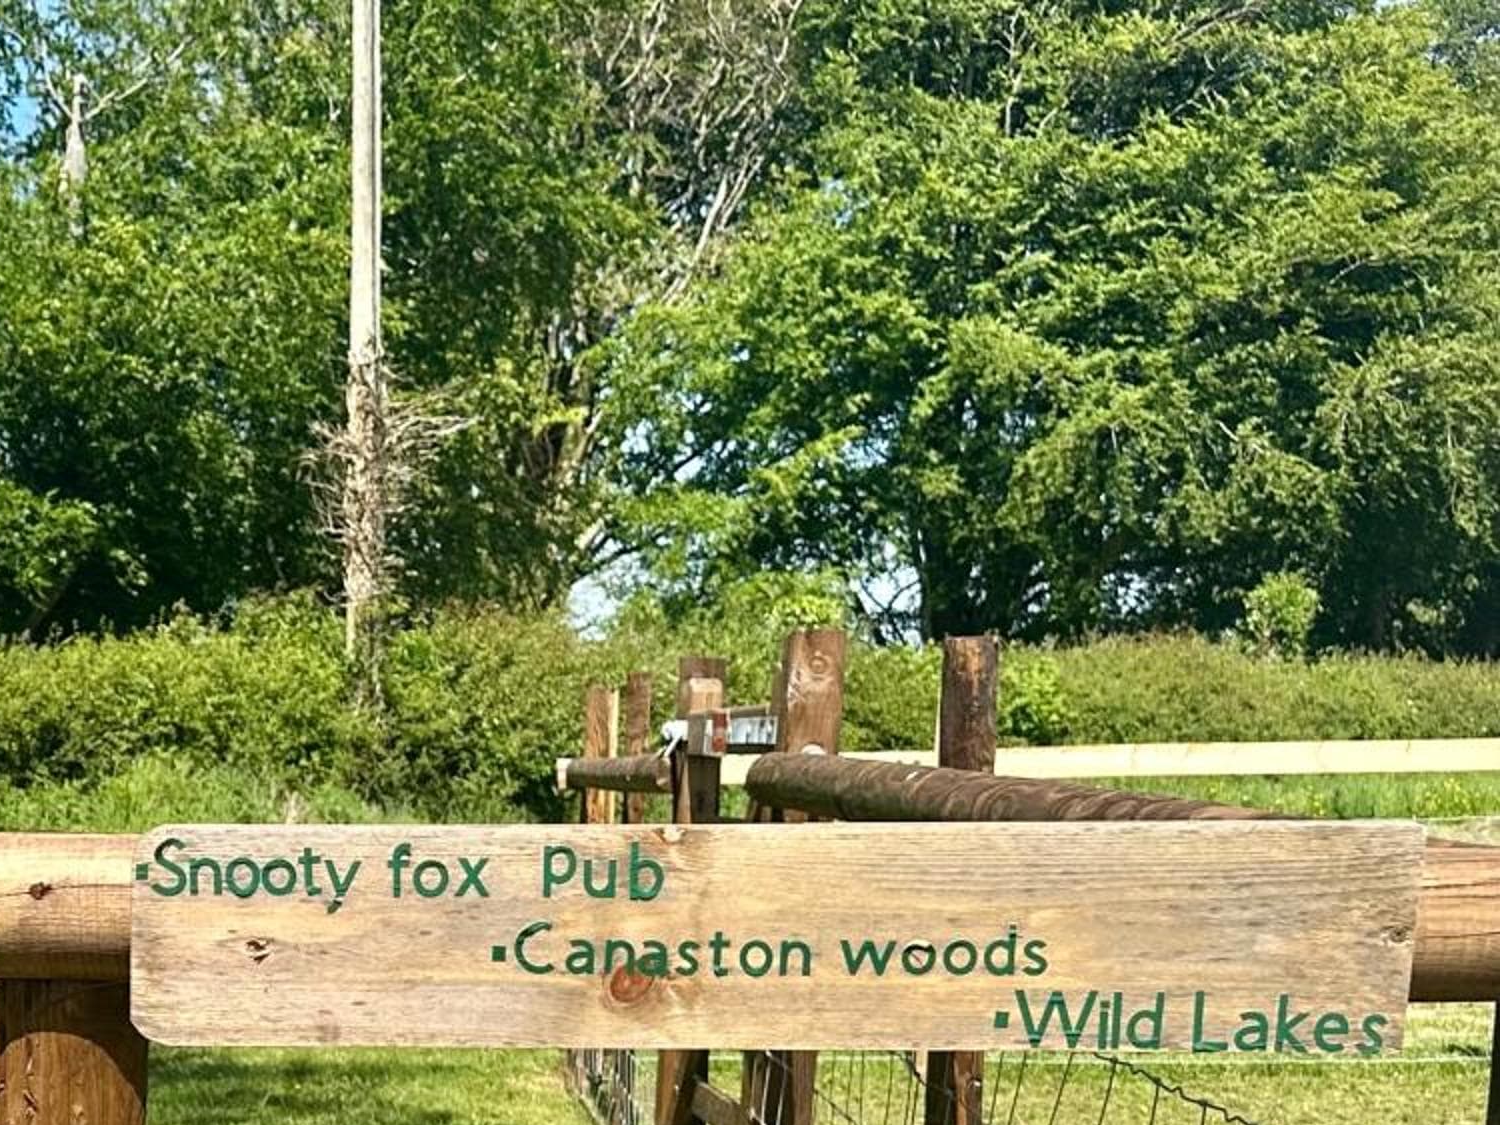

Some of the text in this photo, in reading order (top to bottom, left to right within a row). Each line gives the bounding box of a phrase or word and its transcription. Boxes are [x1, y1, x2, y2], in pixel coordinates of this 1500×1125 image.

[150, 837, 666, 914] Snooty fox Pub
[514, 921, 1048, 977] Canaston woods
[1015, 989, 1390, 1057] Wild Lakes
